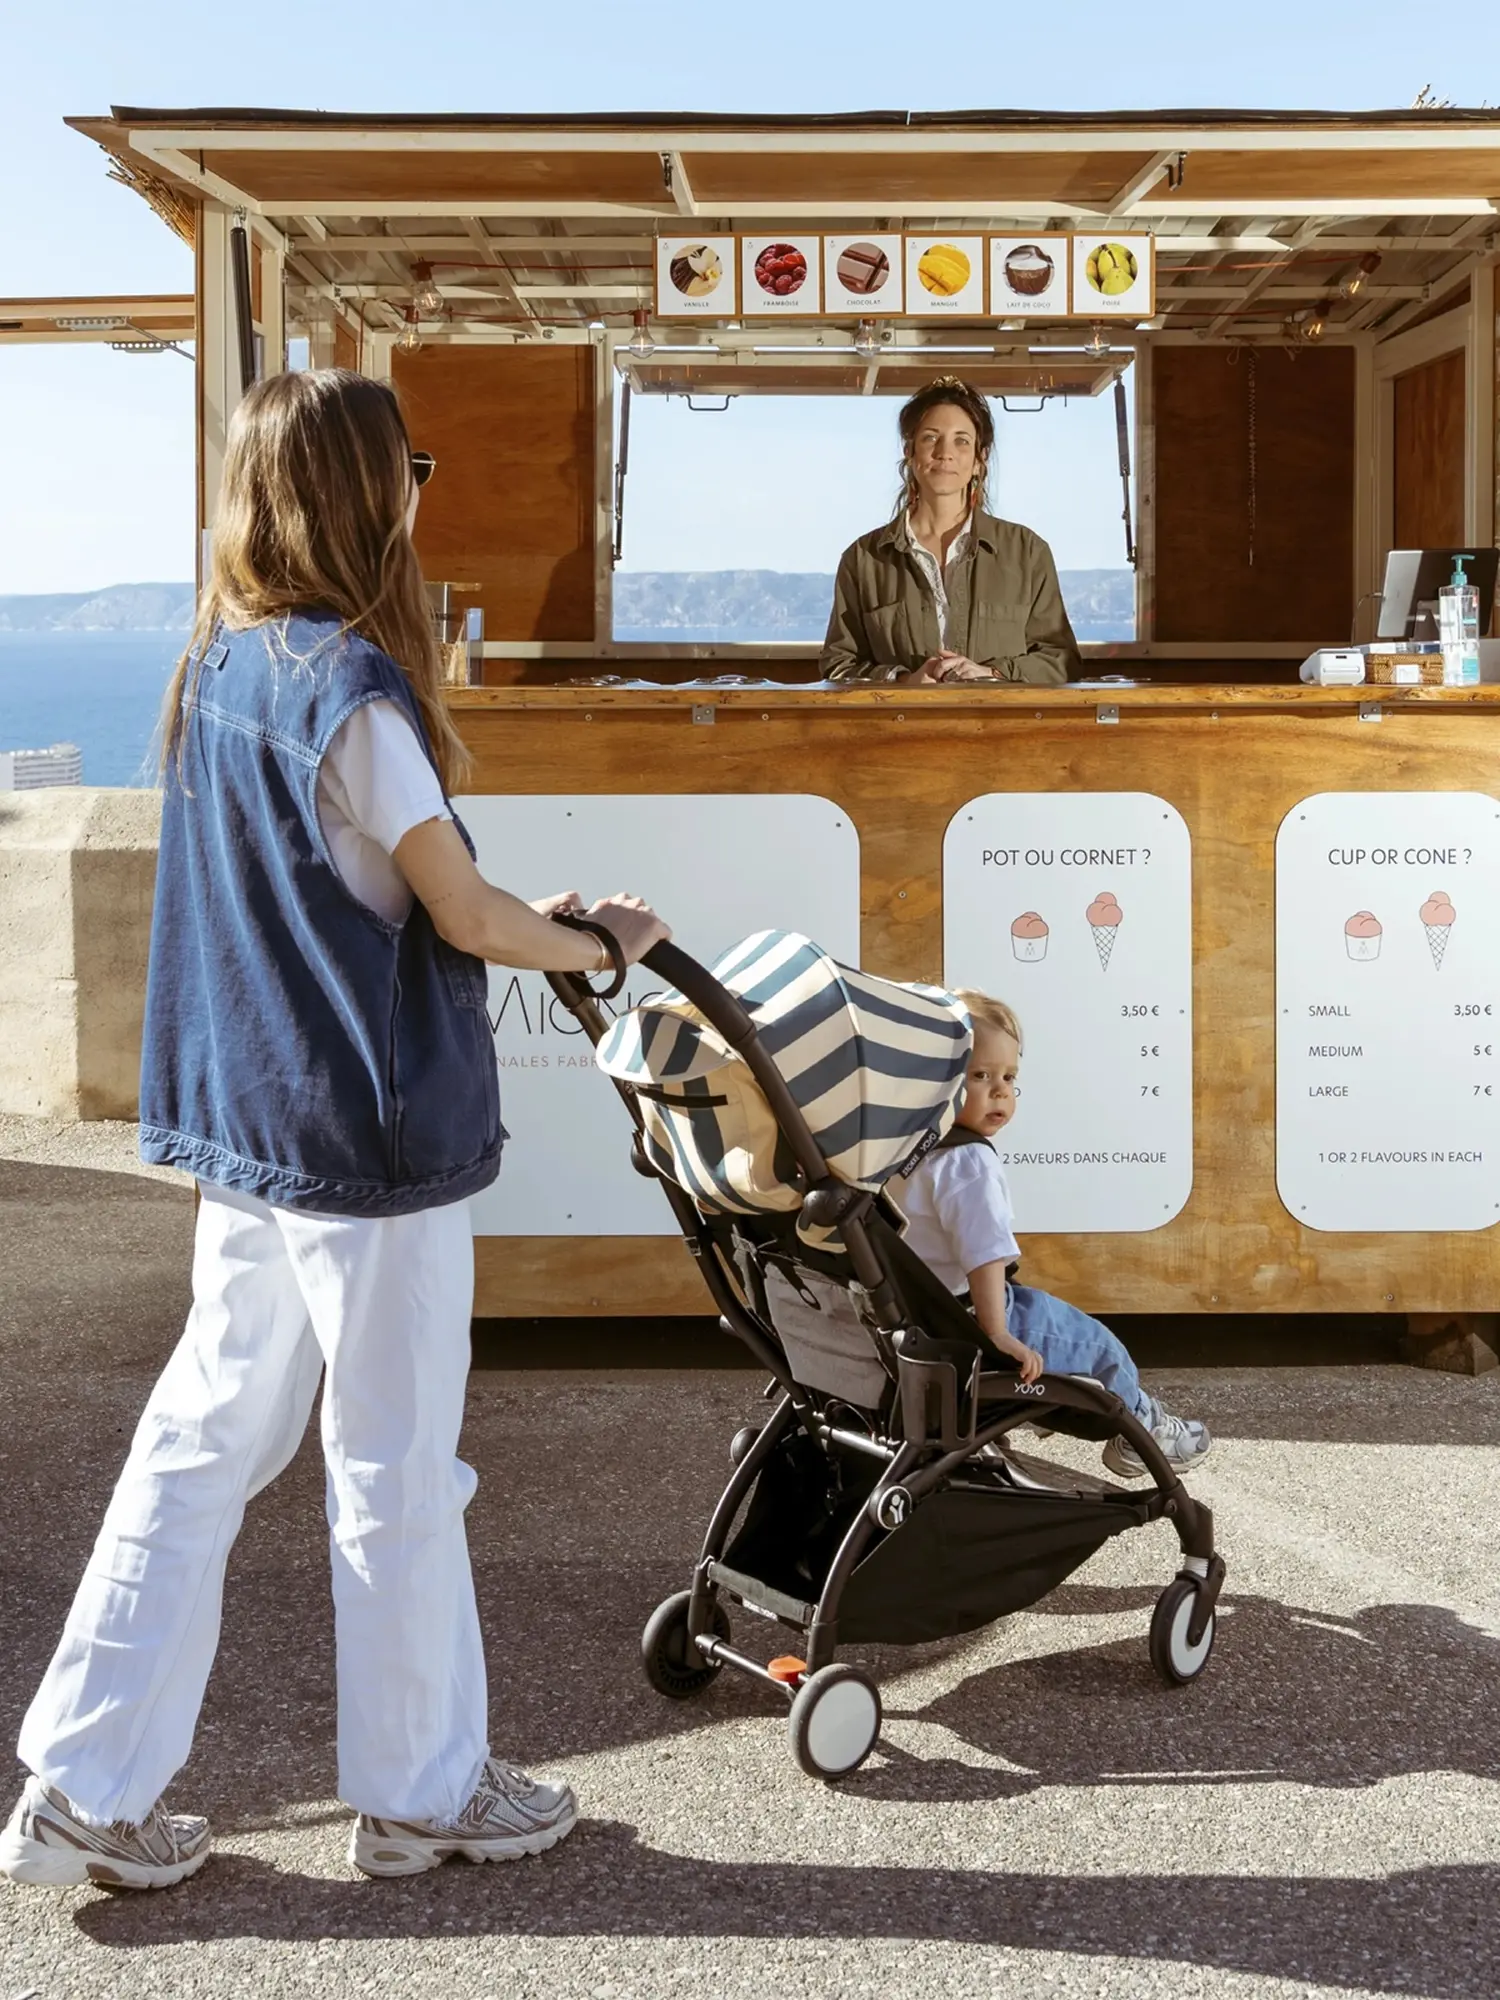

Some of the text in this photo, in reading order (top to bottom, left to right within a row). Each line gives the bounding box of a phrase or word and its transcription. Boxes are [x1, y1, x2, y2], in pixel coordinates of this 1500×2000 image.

[762, 299, 799, 307] FRAMBOISE
[846, 298, 881, 306] CHOCOLAT
[930, 300, 958, 308] MANGUE
[982, 847, 1152, 866] POT OU CORNET ?
[1327, 847, 1473, 866] CUP OR CONE ?
[1120, 1005, 1160, 1018] 3,50 €
[1308, 1004, 1493, 1017] SMALL 3,50 €
[1140, 1045, 1160, 1057] 5 €
[1308, 1044, 1493, 1057] MEDIUM 5 €
[1140, 1085, 1160, 1097] 7 €
[1308, 1084, 1493, 1097] LARGE 7 €
[1002, 1151, 1167, 1165] 2 SAVEURS DANS CHAQUE
[1318, 1151, 1483, 1164] 1 OR 2 FLAVOURS IN EACH
[1014, 1382, 1046, 1396] YOYO
